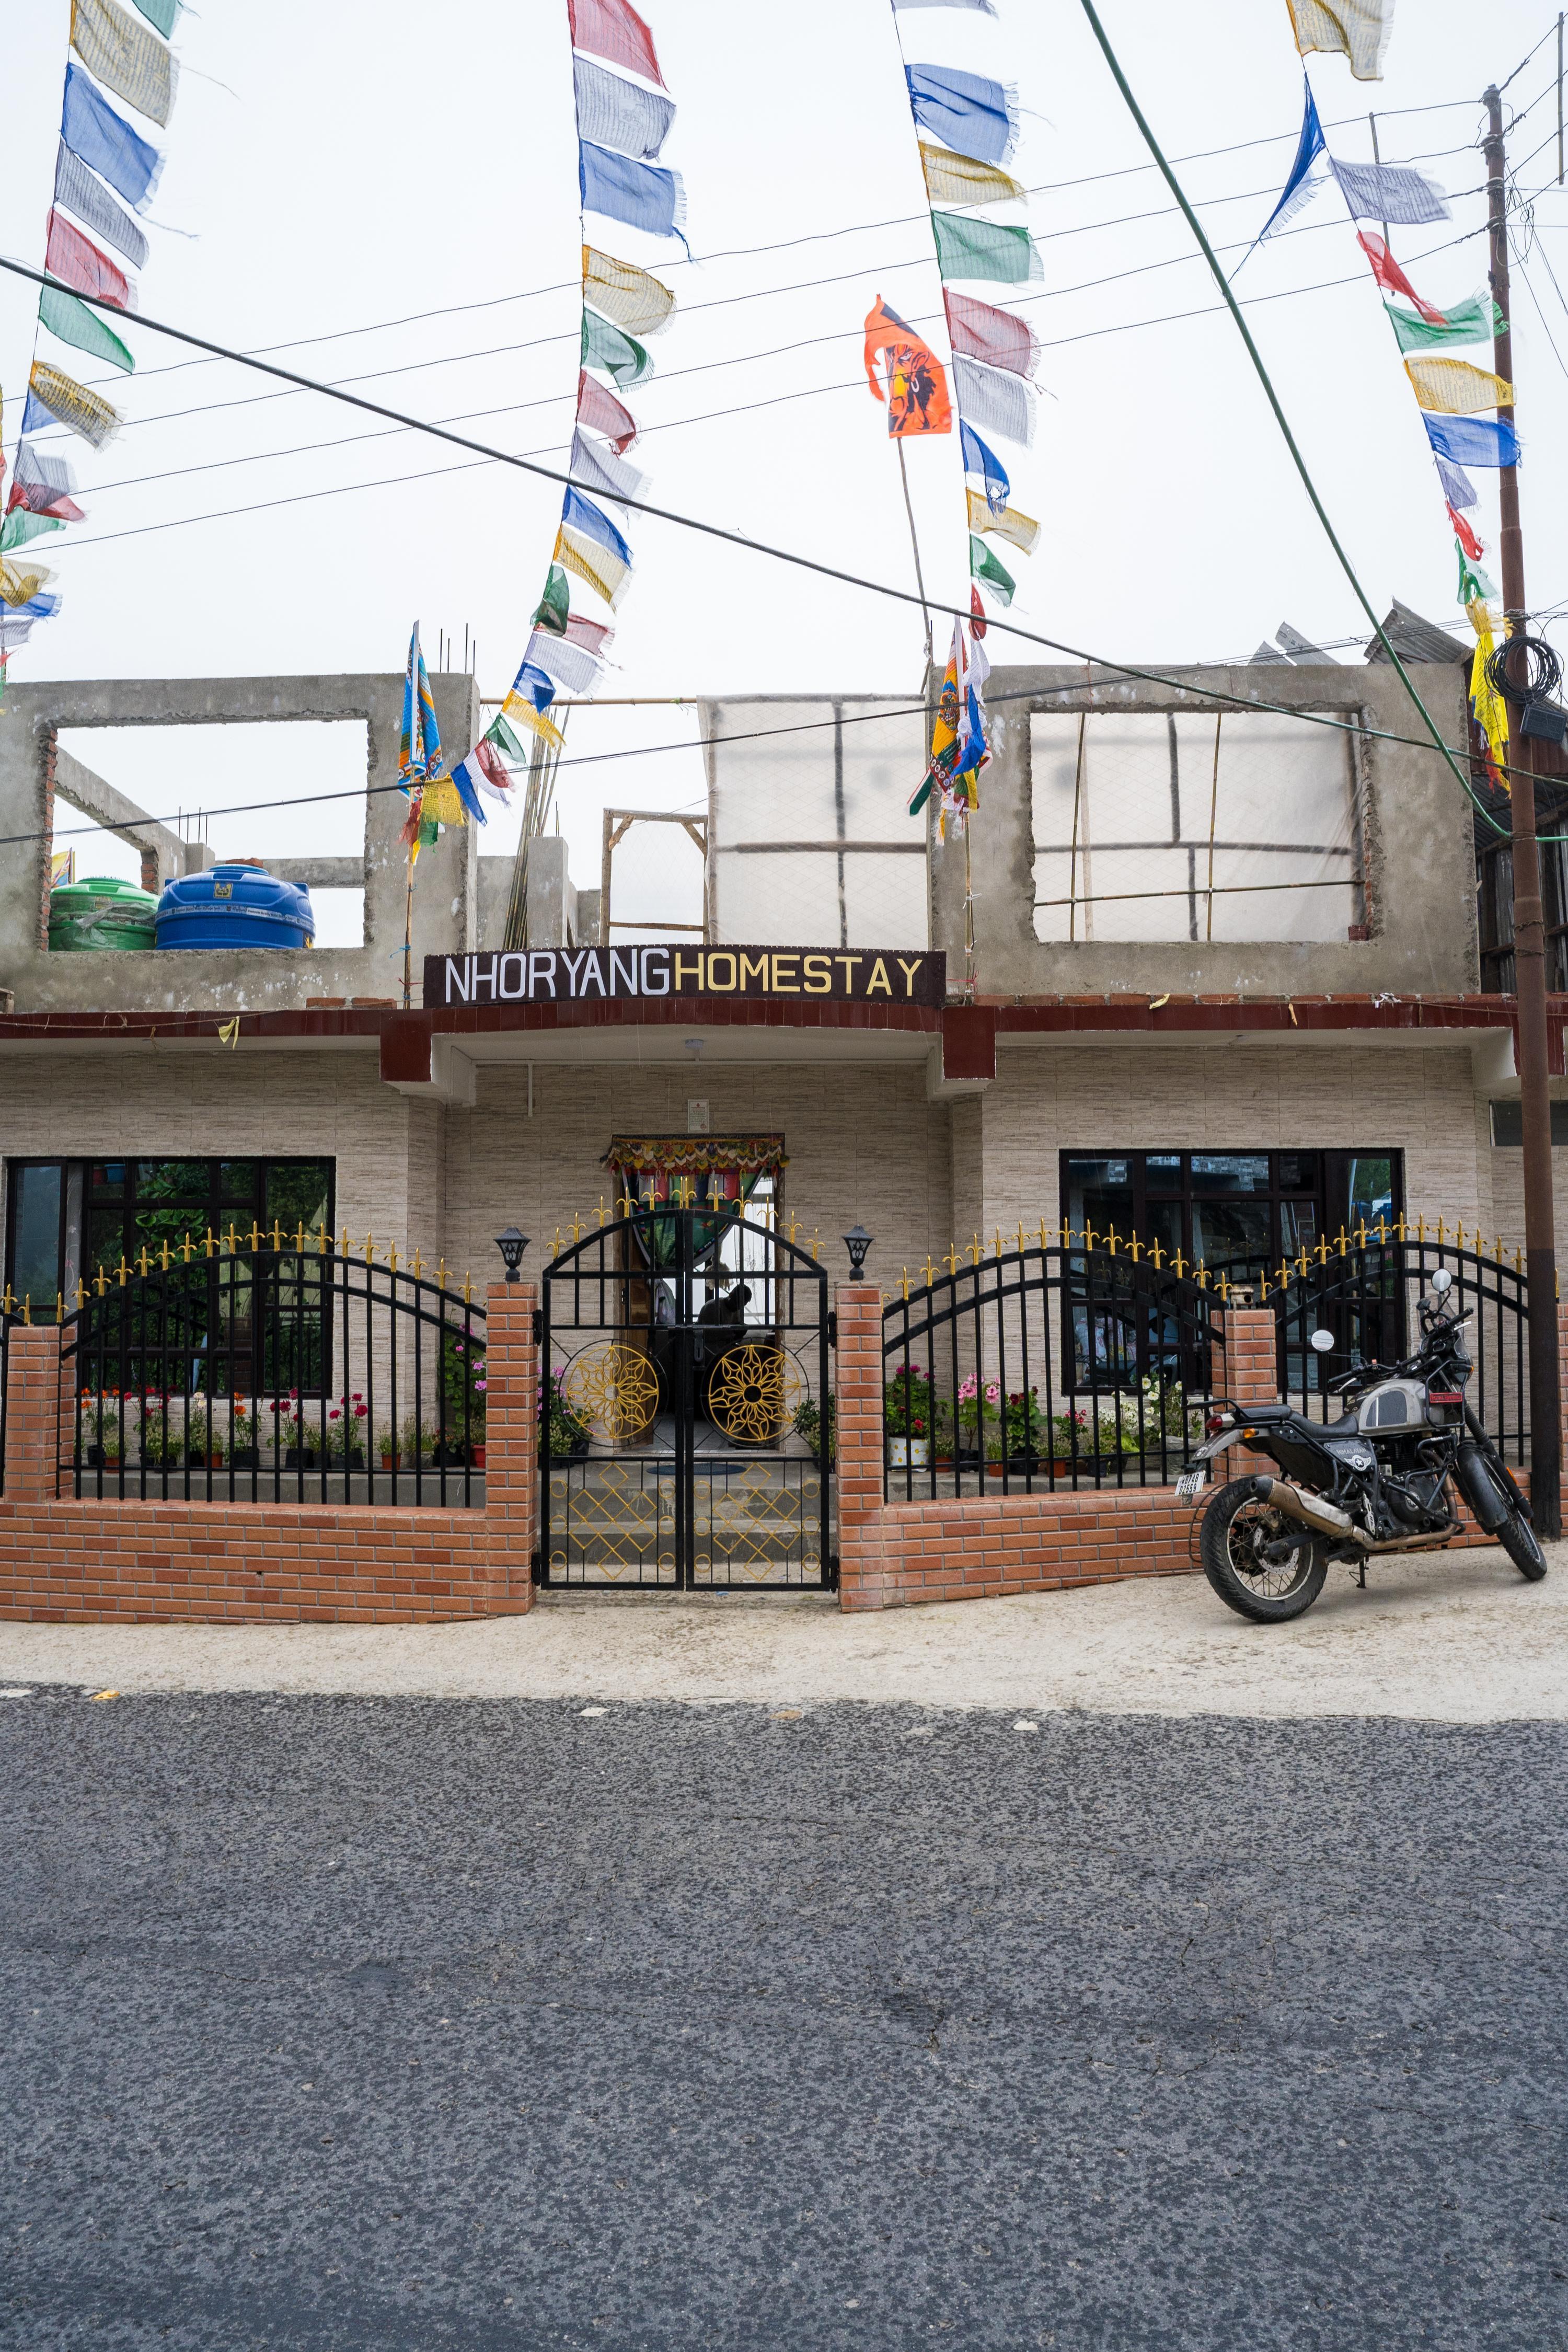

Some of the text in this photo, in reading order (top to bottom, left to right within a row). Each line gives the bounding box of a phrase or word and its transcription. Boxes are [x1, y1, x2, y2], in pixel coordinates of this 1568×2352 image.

[445, 948, 923, 1003] NHORYANG HOMESTAY
[1179, 1483, 1196, 1494] D2559
